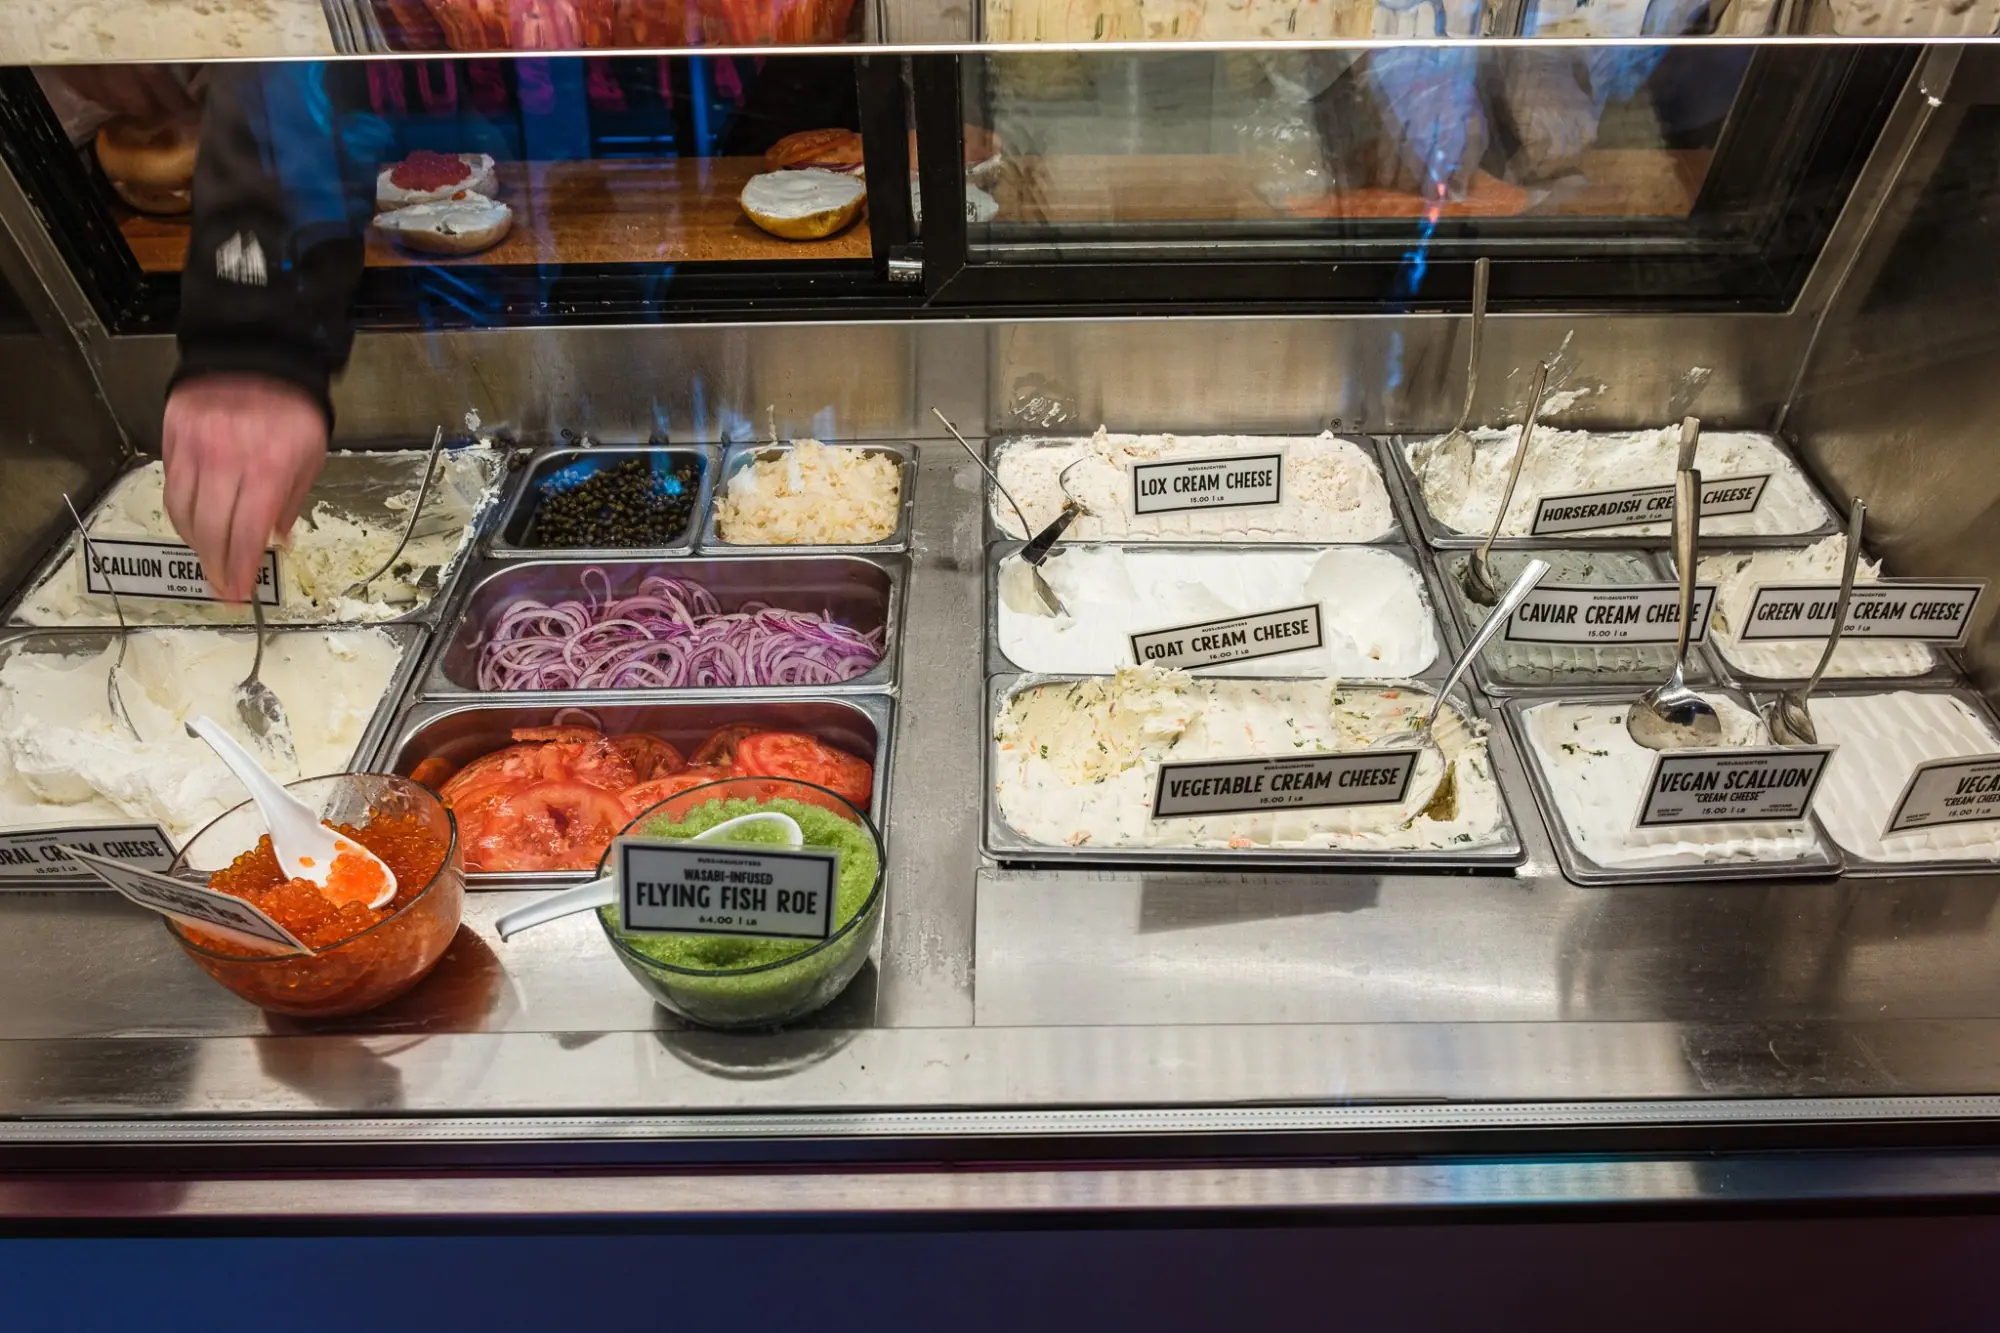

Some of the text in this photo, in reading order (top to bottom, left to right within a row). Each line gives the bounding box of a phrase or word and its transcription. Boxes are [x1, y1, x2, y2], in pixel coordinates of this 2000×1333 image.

[1141, 470, 1272, 496] LOX CREAM CHEESE
[1542, 486, 1756, 522] HORSERADISH CRE CHEESE
[92, 556, 208, 581] SCALLION CREA
[1519, 603, 1701, 624] CAVIAR CREAM CHEEE
[1757, 602, 1965, 621] GREEN OLIV CREAM CHEESE
[1145, 619, 1310, 660] GOAT CREAM CHEESE
[1170, 767, 1400, 798] VEGETABLE CREAM CHEESE
[1660, 767, 1814, 793] VEGAN SCALLION
[1956, 774, 2000, 795] VEGA
[103, 841, 165, 858] CHEESE
[684, 868, 773, 885] WASABI-INFUSED
[636, 882, 818, 915] FLYING FISH ROE
